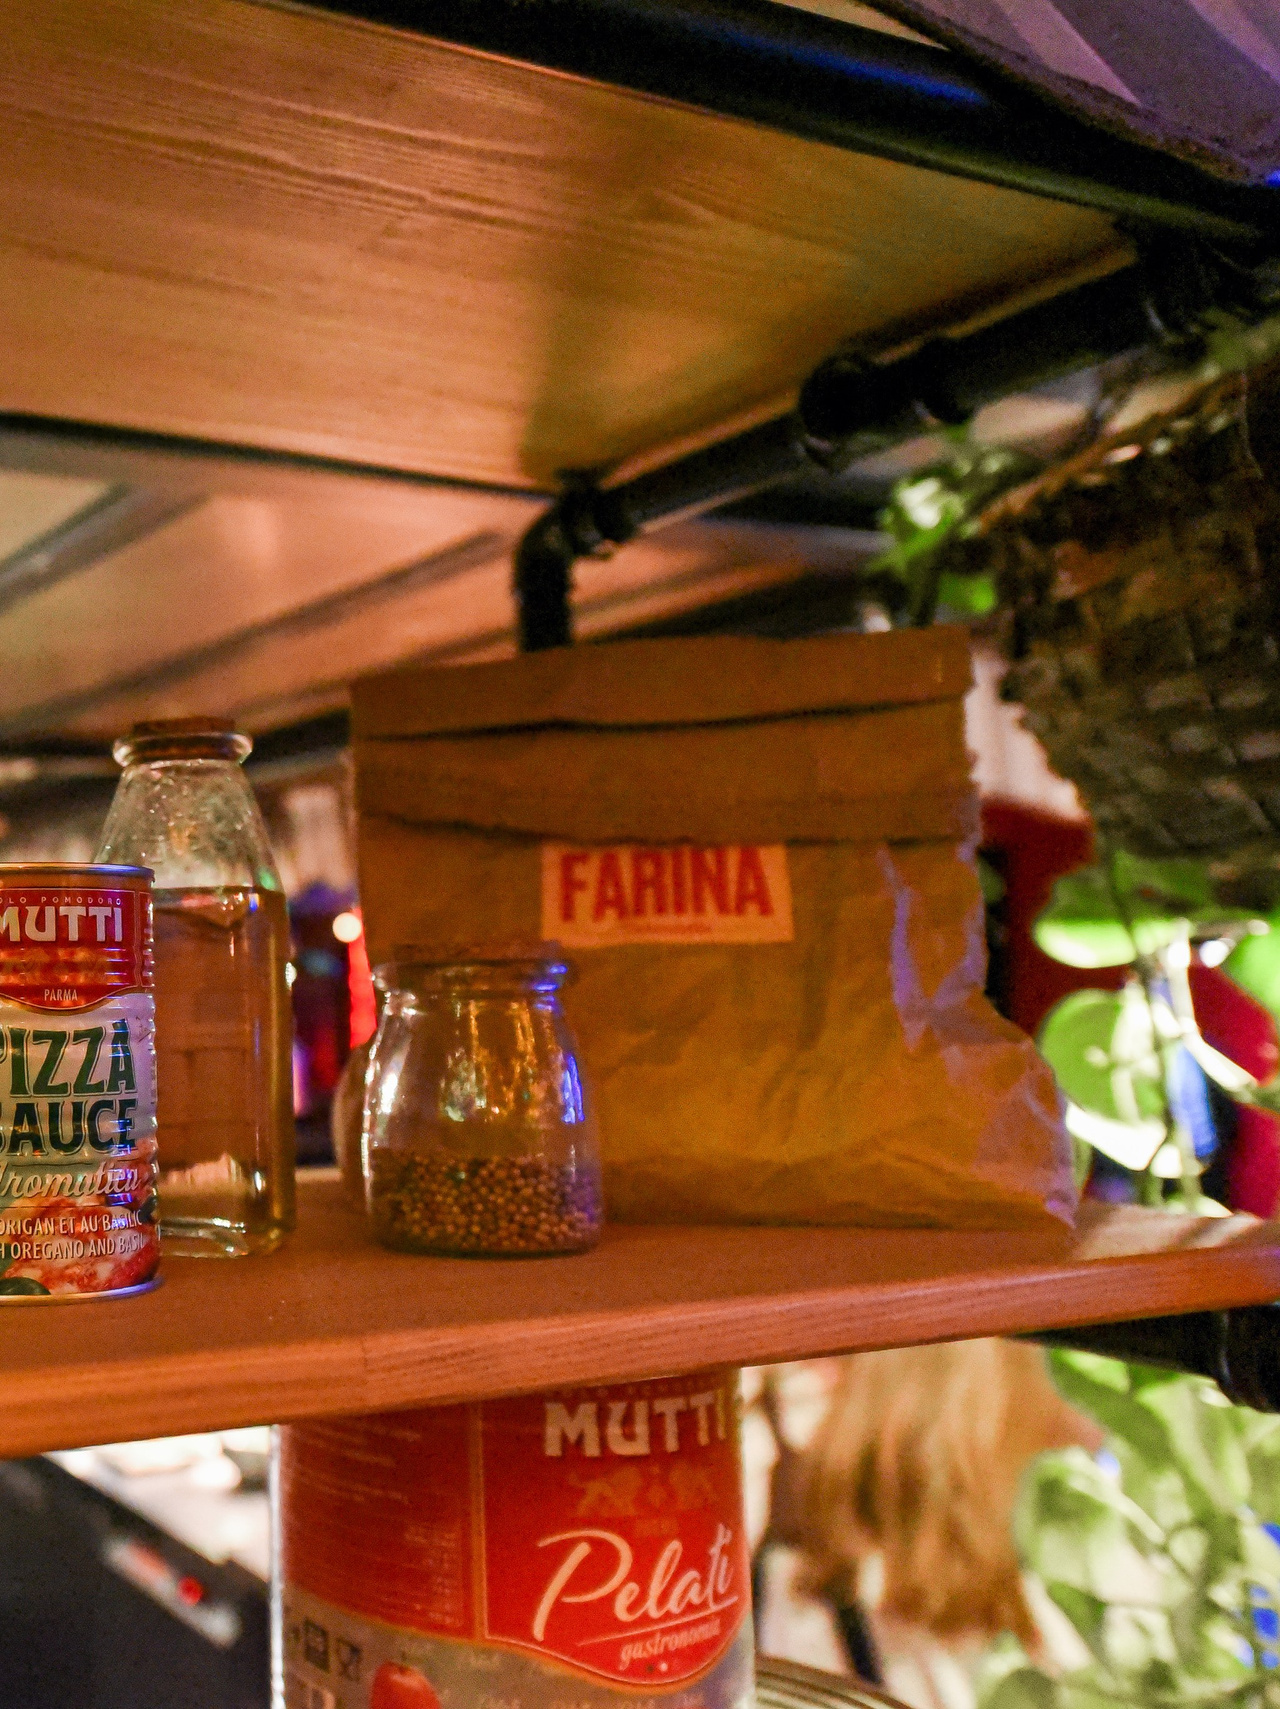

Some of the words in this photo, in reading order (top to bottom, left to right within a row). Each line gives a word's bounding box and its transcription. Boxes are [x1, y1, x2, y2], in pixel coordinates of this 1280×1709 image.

[560, 847, 774, 923] FARINA
[41, 896, 121, 906] POMODORO
[44, 988, 78, 1001] PARMA
[60, 1217, 75, 1234] ET
[80, 1217, 98, 1233] AU
[102, 1210, 143, 1231] BASILIC
[10, 1240, 84, 1260] OREGANO
[88, 1238, 115, 1257] AND
[119, 1233, 145, 1254] BASIL
[544, 1391, 727, 1457] MUTTI
[534, 1523, 739, 1642] Pelati
